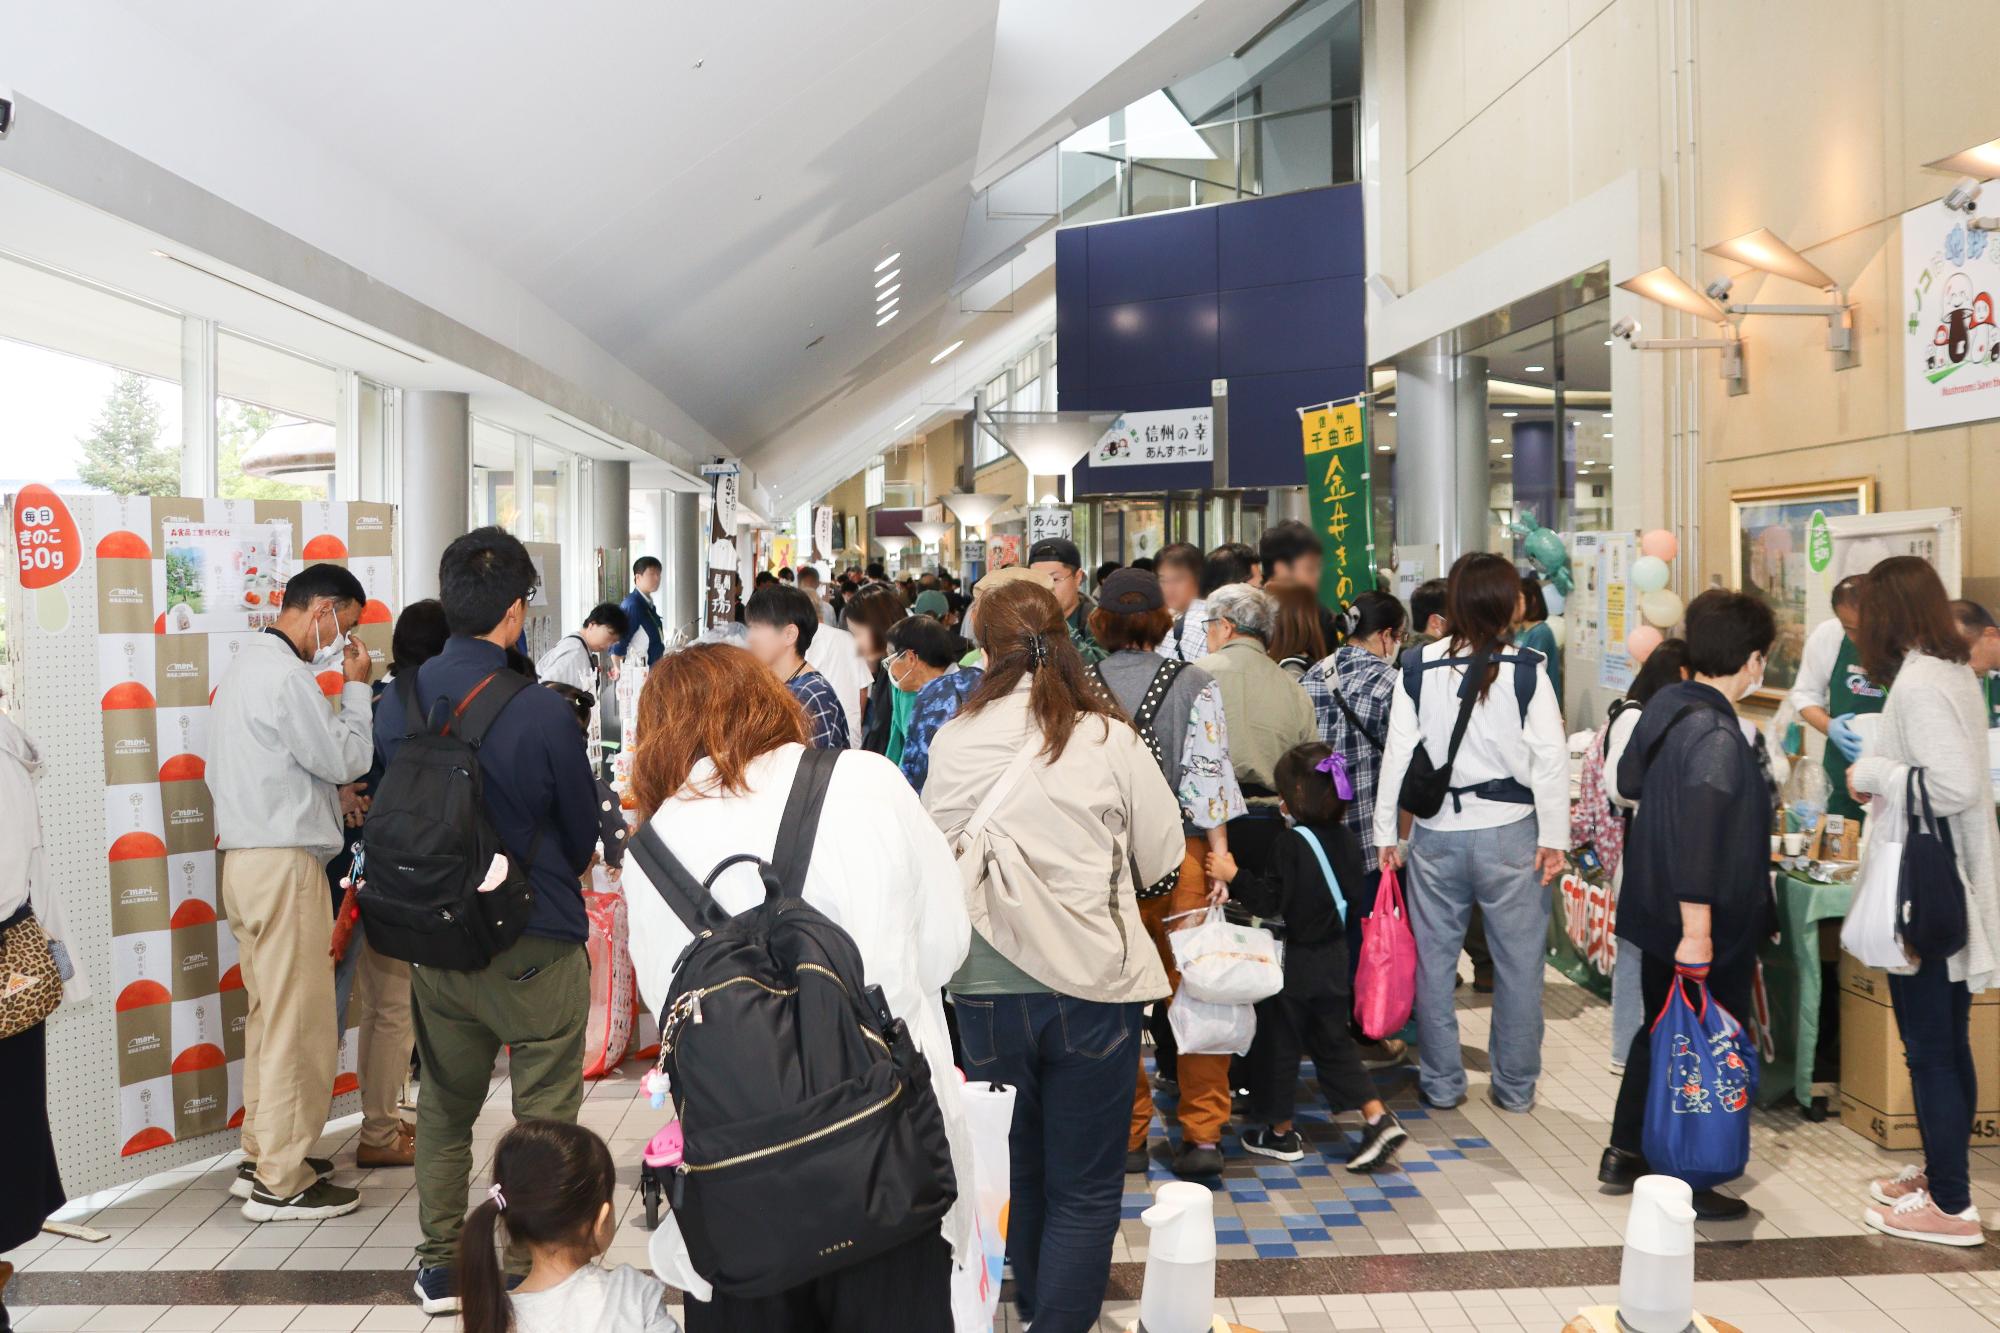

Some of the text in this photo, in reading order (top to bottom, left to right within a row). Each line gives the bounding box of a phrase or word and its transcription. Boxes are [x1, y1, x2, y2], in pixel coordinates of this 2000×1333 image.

[1145, 423, 1208, 443] 信州の幸
[1311, 426, 1355, 450] 千曲市
[1146, 443, 1208, 459] あんずホール
[25, 509, 50, 522] 毎日
[1033, 514, 1070, 527] あんず
[19, 528, 61, 546] きのこ
[21, 547, 64, 570] 50g
[818, 1239, 854, 1256] TOCCA
